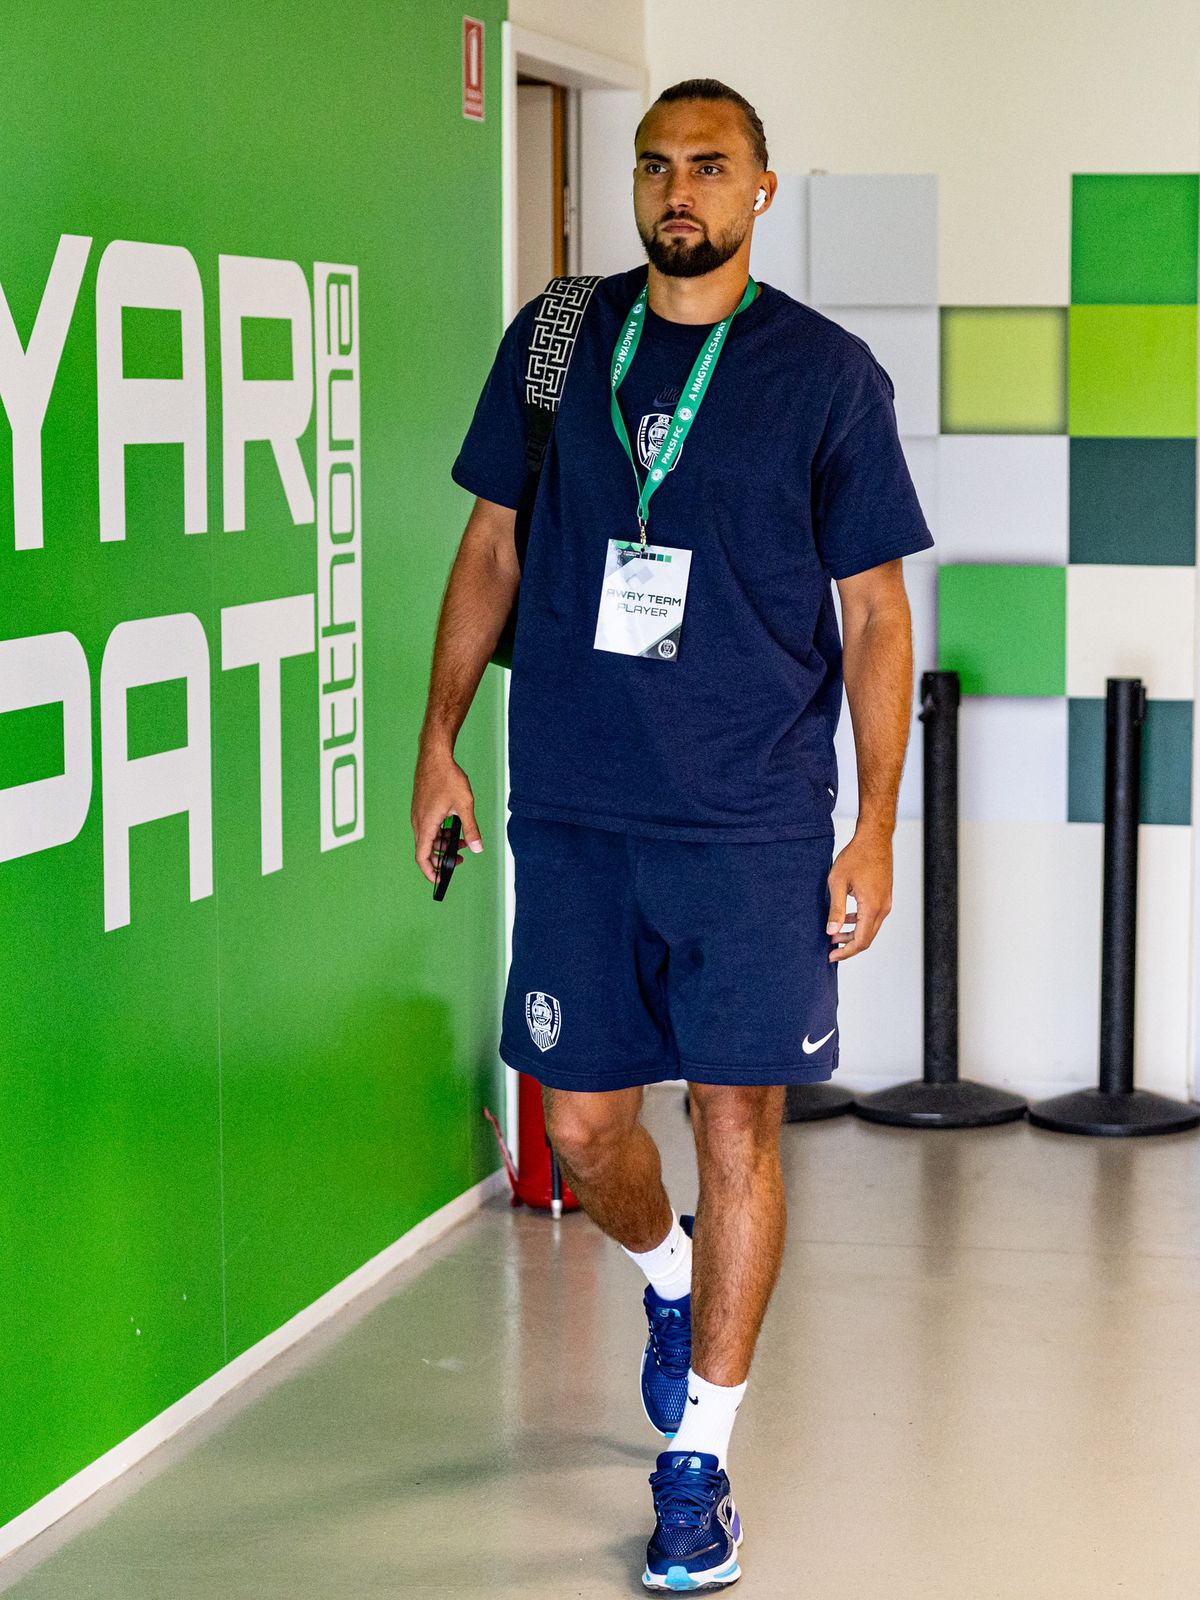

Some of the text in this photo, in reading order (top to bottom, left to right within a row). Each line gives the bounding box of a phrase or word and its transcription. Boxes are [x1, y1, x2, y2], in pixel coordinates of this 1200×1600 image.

[617, 328, 636, 363] MAGYAR
[688, 321, 727, 402] A MAGYAR CSAPAT
[0, 234, 315, 551] YAR
[661, 425, 684, 464] PAKSI FC
[321, 272, 358, 838] otthona
[606, 588, 682, 607] AWAY TEAM
[617, 602, 668, 618] PLAYER
